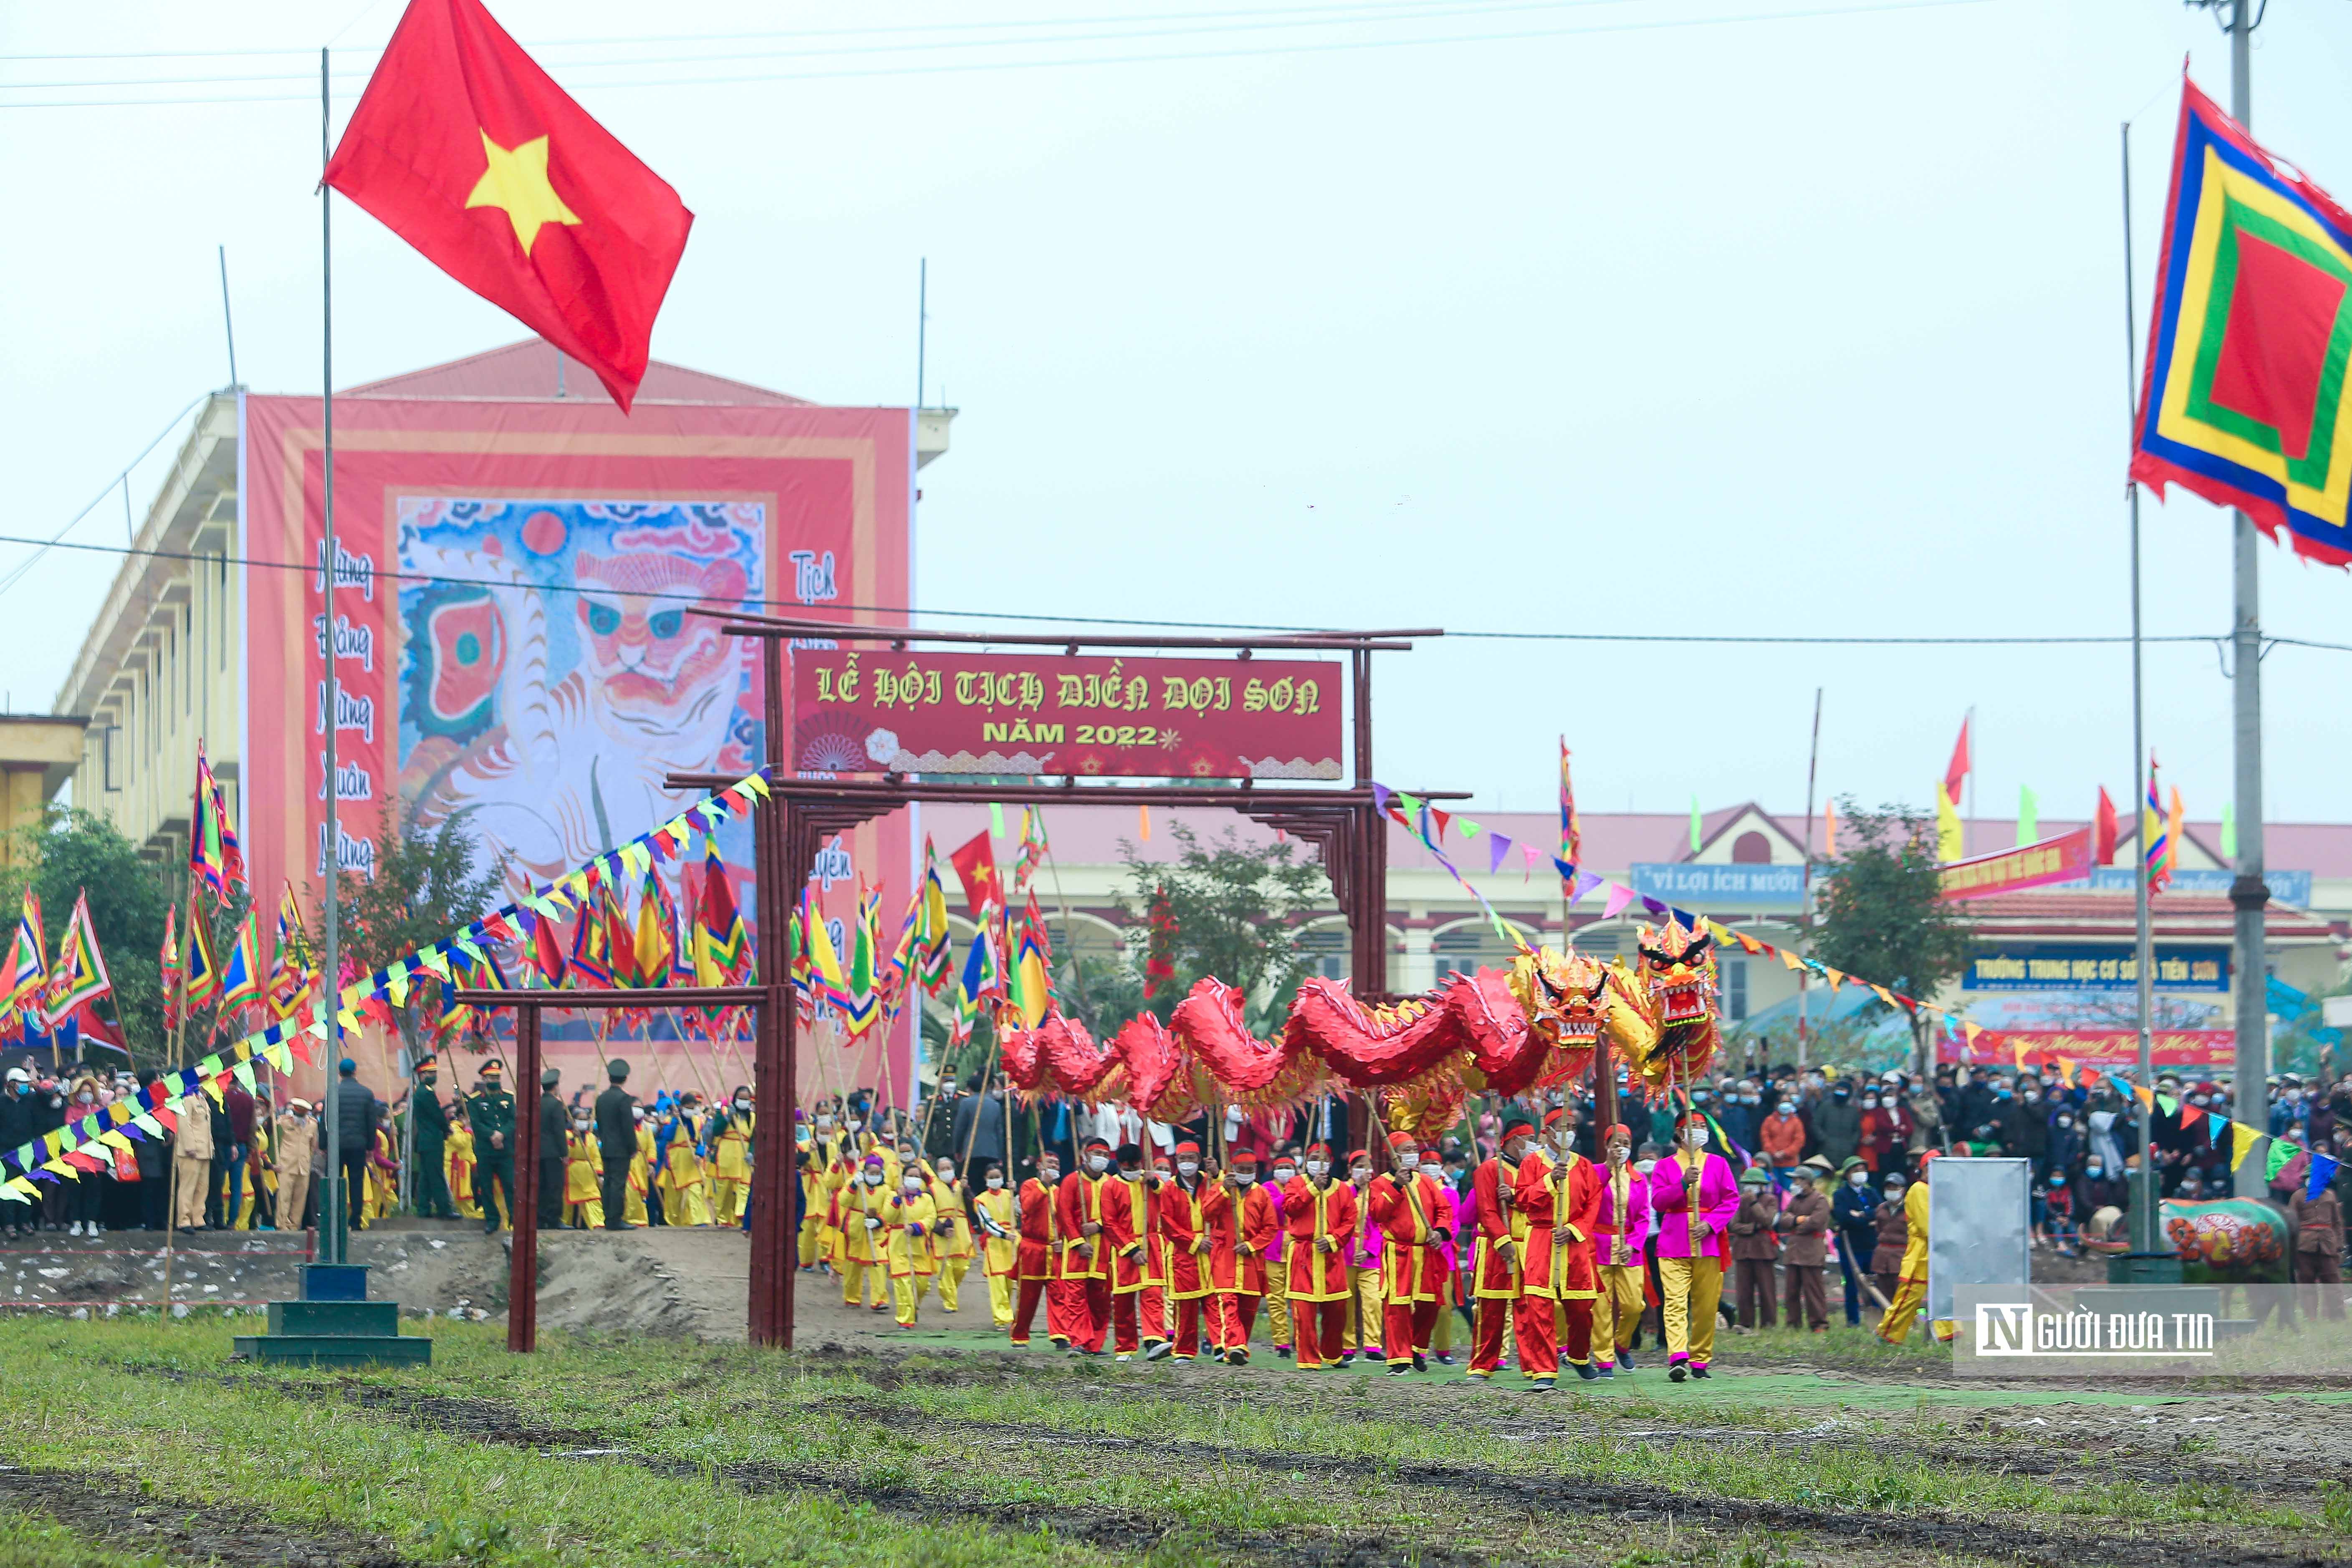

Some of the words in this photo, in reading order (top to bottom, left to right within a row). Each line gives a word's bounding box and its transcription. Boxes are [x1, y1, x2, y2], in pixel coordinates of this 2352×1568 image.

[791, 553, 836, 604] Tịch
[815, 652, 860, 703] LỄ
[873, 661, 942, 711] HỘI
[955, 670, 1045, 713] TỊCH
[1243, 676, 1320, 716] SƠN
[983, 718, 1065, 744] NĂM
[1075, 725, 1157, 746] 2022
[2029, 959, 2070, 980] TRUNG
[2072, 959, 2097, 982] HỌC
